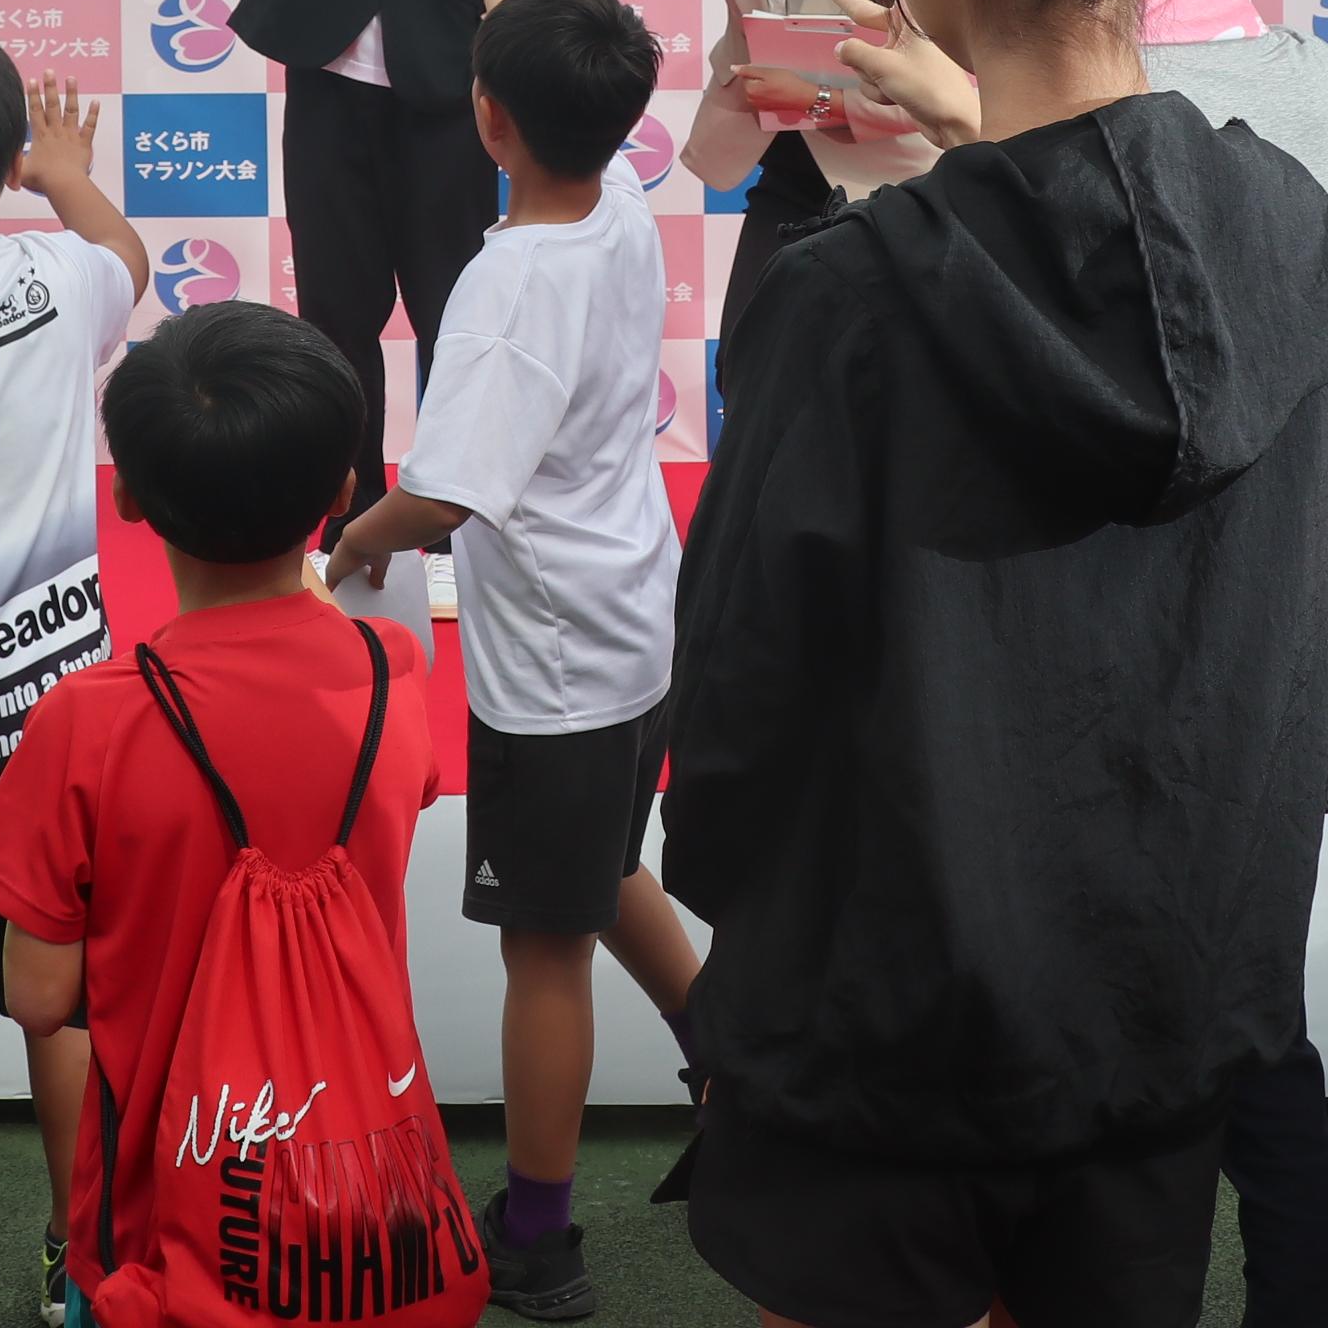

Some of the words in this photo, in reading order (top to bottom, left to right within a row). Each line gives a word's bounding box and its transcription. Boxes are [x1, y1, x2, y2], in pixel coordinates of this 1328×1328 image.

[135, 130, 209, 151] さくら市
[135, 159, 257, 180] マラソン大会
[475, 875, 500, 887] adidas
